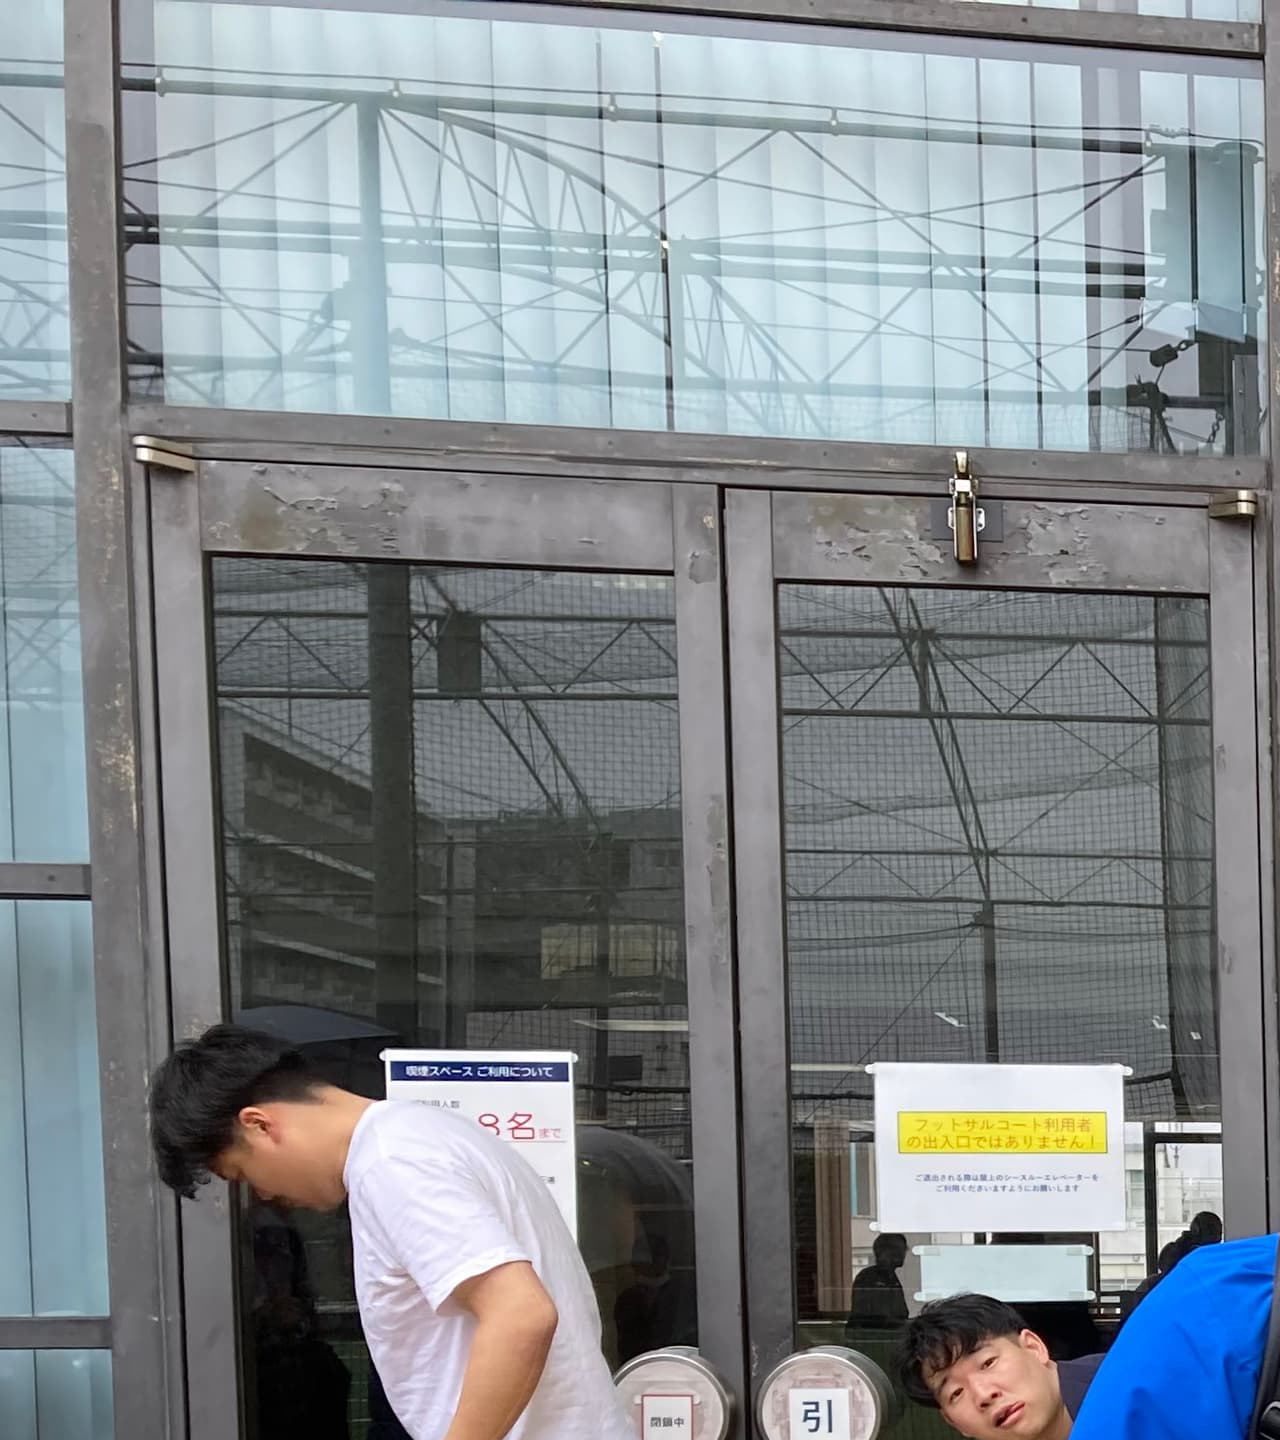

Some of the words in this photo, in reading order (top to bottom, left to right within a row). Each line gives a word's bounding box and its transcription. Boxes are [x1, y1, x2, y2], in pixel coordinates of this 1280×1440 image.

[914, 1117, 1093, 1133] フットサルコート利用者
[802, 1399, 833, 1433] 引
